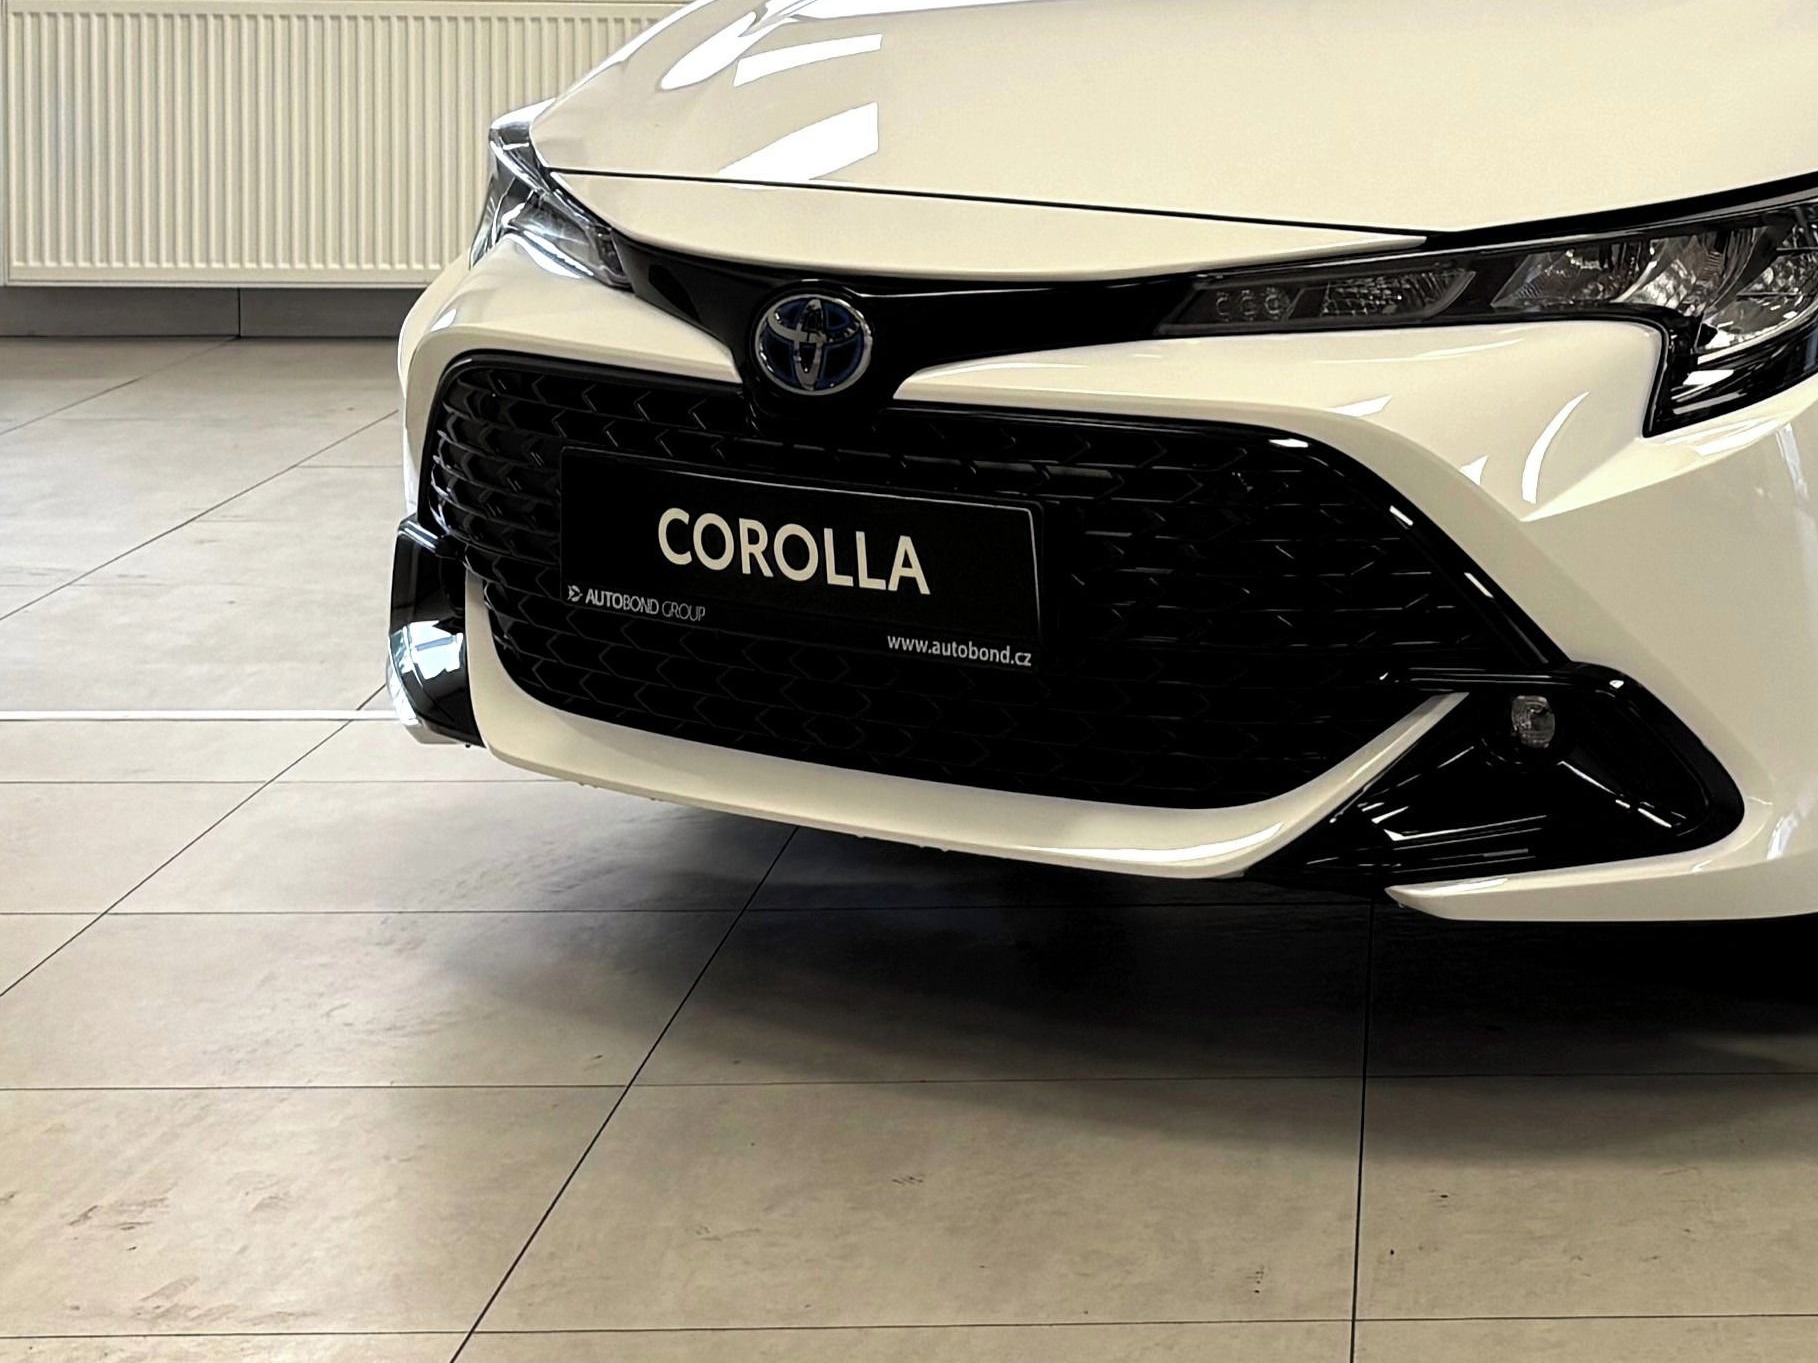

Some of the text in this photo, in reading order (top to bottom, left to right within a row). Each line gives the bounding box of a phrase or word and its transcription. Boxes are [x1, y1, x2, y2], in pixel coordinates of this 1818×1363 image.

[657, 507, 931, 595] COROLLA
[585, 588, 706, 622] AUTOBOND GROUP
[887, 635, 1032, 667] www.autobond.cz
